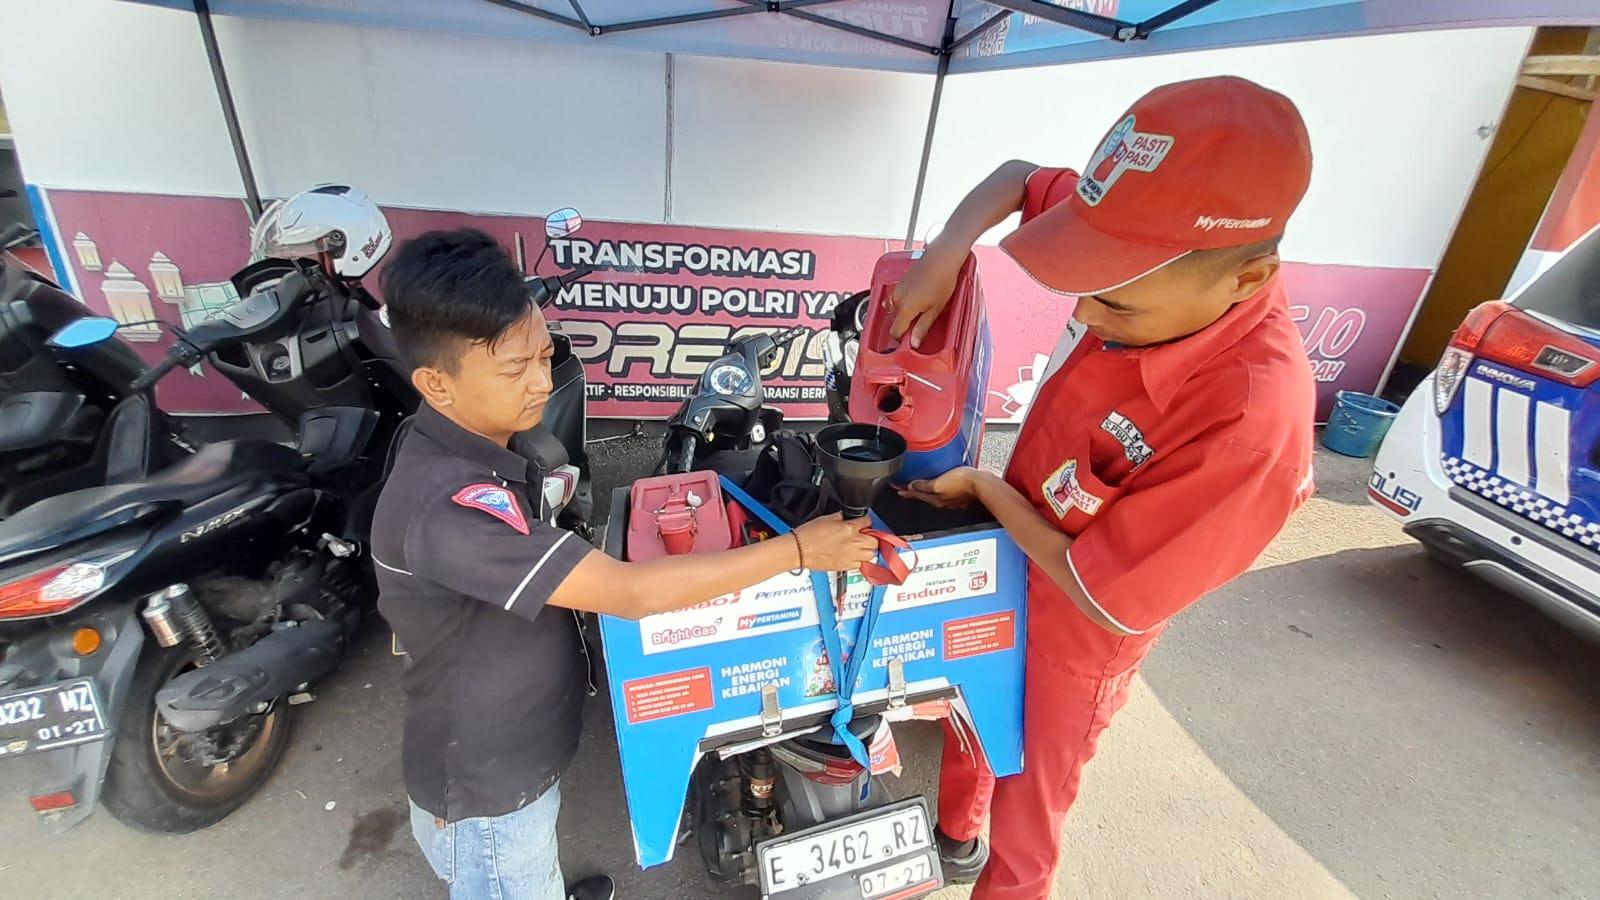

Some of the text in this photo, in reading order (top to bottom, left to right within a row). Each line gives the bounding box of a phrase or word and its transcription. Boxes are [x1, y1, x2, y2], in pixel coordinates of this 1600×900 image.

[1132, 136, 1168, 153] PASTI
[550, 239, 811, 275] TRANSFORMASI
[555, 282, 692, 310] MENUJU
[701, 289, 794, 314] POLRI
[1475, 364, 1537, 391] INNOVA
[897, 585, 956, 602] Enduro
[652, 626, 717, 645] Bright Gas
[873, 629, 934, 649] HARMONI
[873, 648, 936, 669] KEAIKAN
[882, 641, 926, 657] ENERGI
[721, 656, 788, 678] HARMONI
[731, 669, 780, 687] ENERGI
[59, 686, 94, 713] MZ
[770, 815, 924, 886] E 3462 RZ
